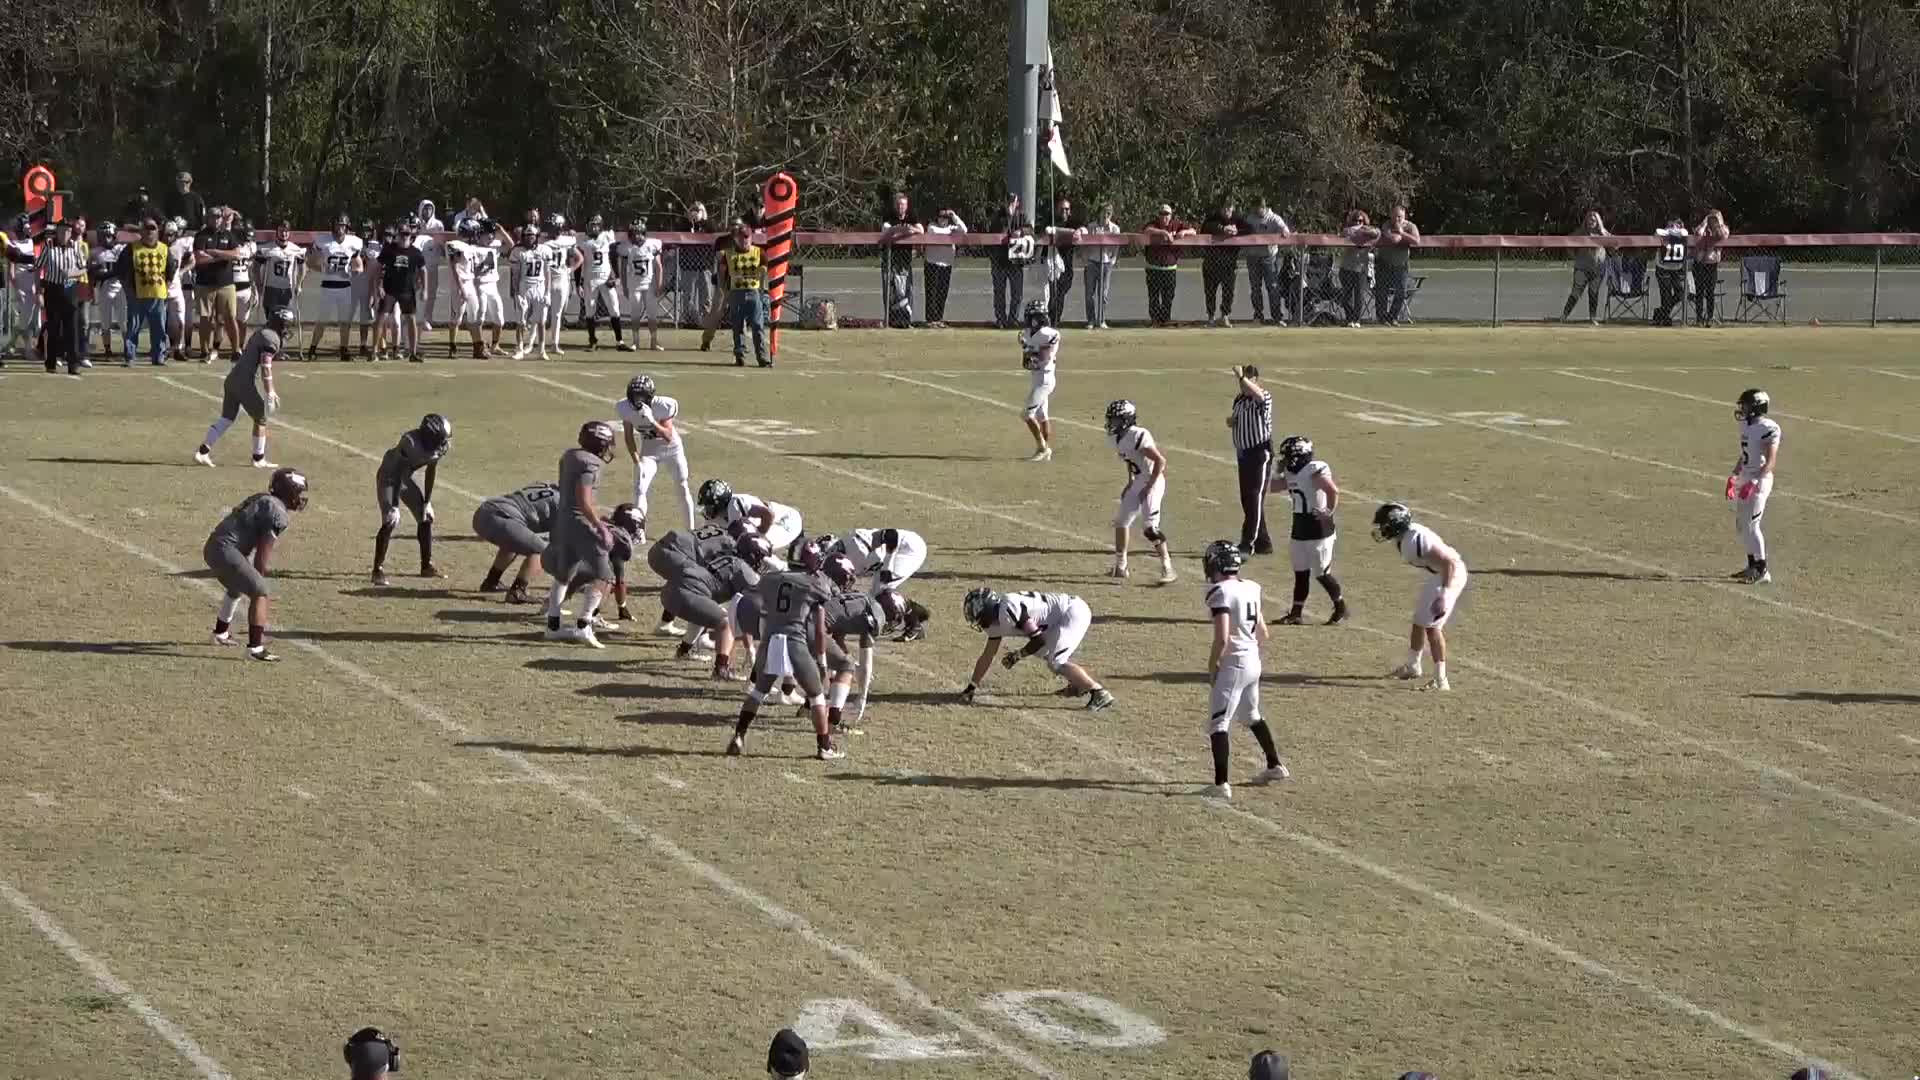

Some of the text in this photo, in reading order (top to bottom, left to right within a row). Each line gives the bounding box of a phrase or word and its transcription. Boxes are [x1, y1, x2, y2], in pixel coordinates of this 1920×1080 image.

[1008, 236, 1035, 259] 20
[1663, 243, 1685, 261] 10
[776, 582, 792, 613] 6
[1246, 601, 1259, 634] 4
[795, 989, 1168, 1060] 40
